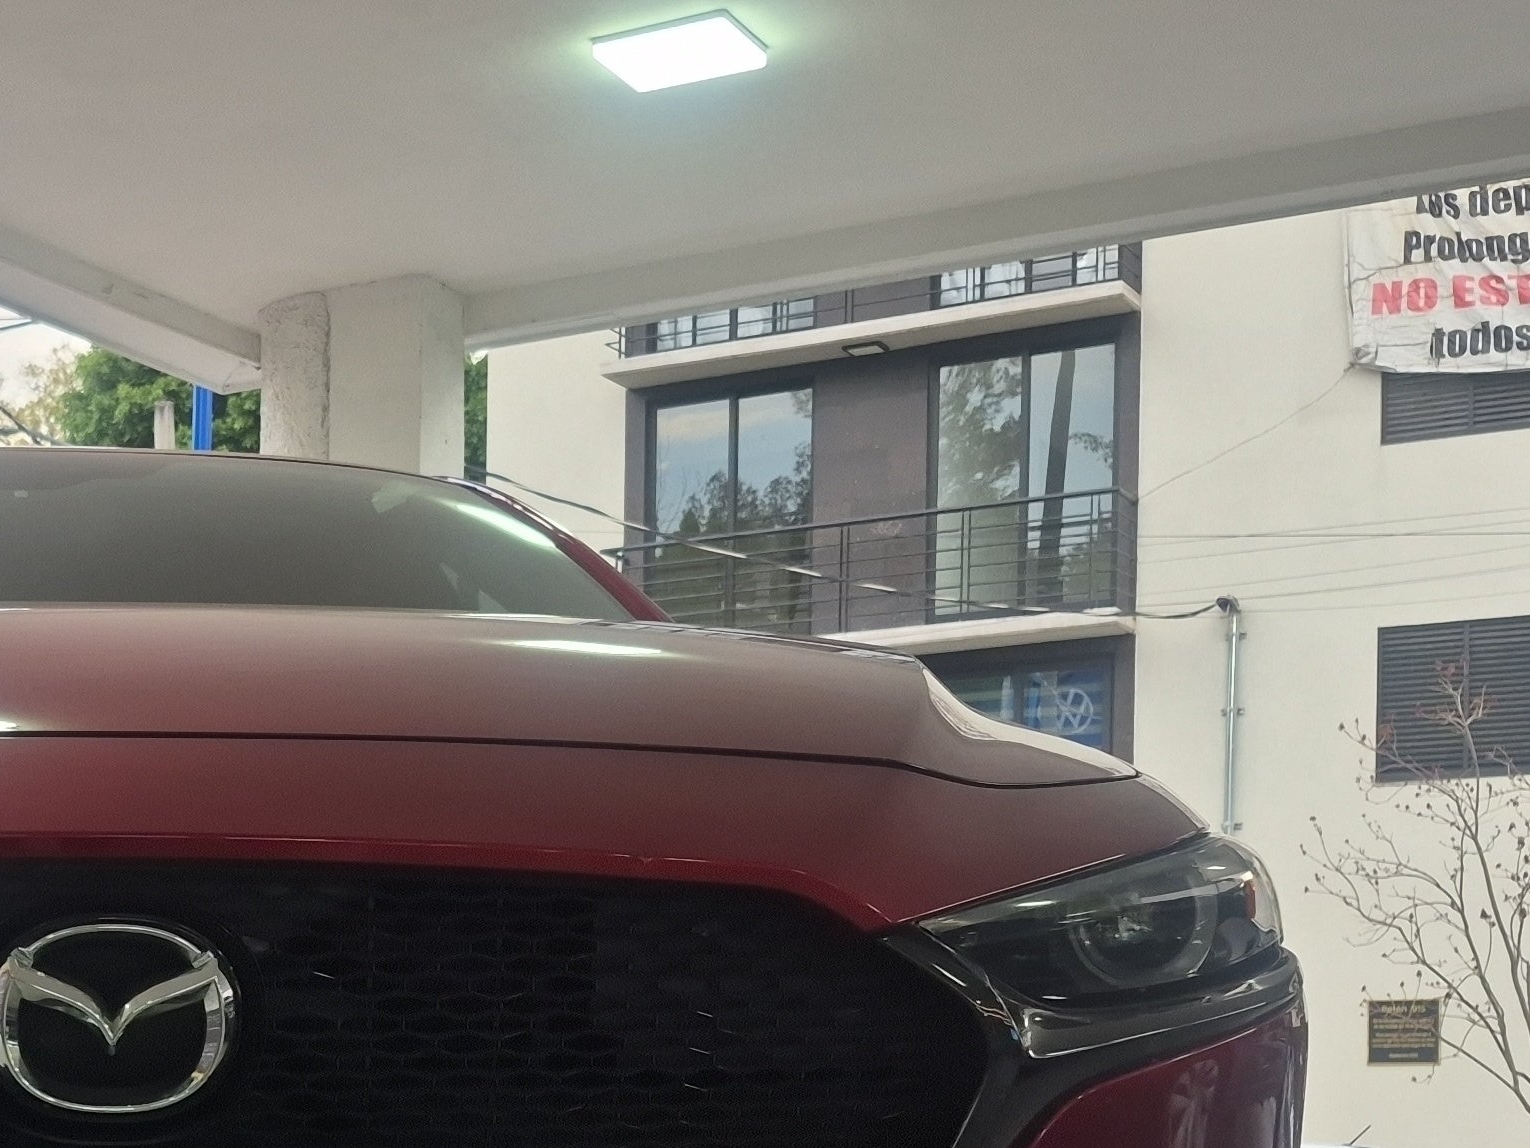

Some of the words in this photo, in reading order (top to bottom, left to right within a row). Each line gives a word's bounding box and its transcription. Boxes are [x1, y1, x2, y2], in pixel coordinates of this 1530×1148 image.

[1404, 230, 1530, 264] Prolong
[1371, 278, 1438, 316] NO
[1430, 321, 1530, 360] todos
